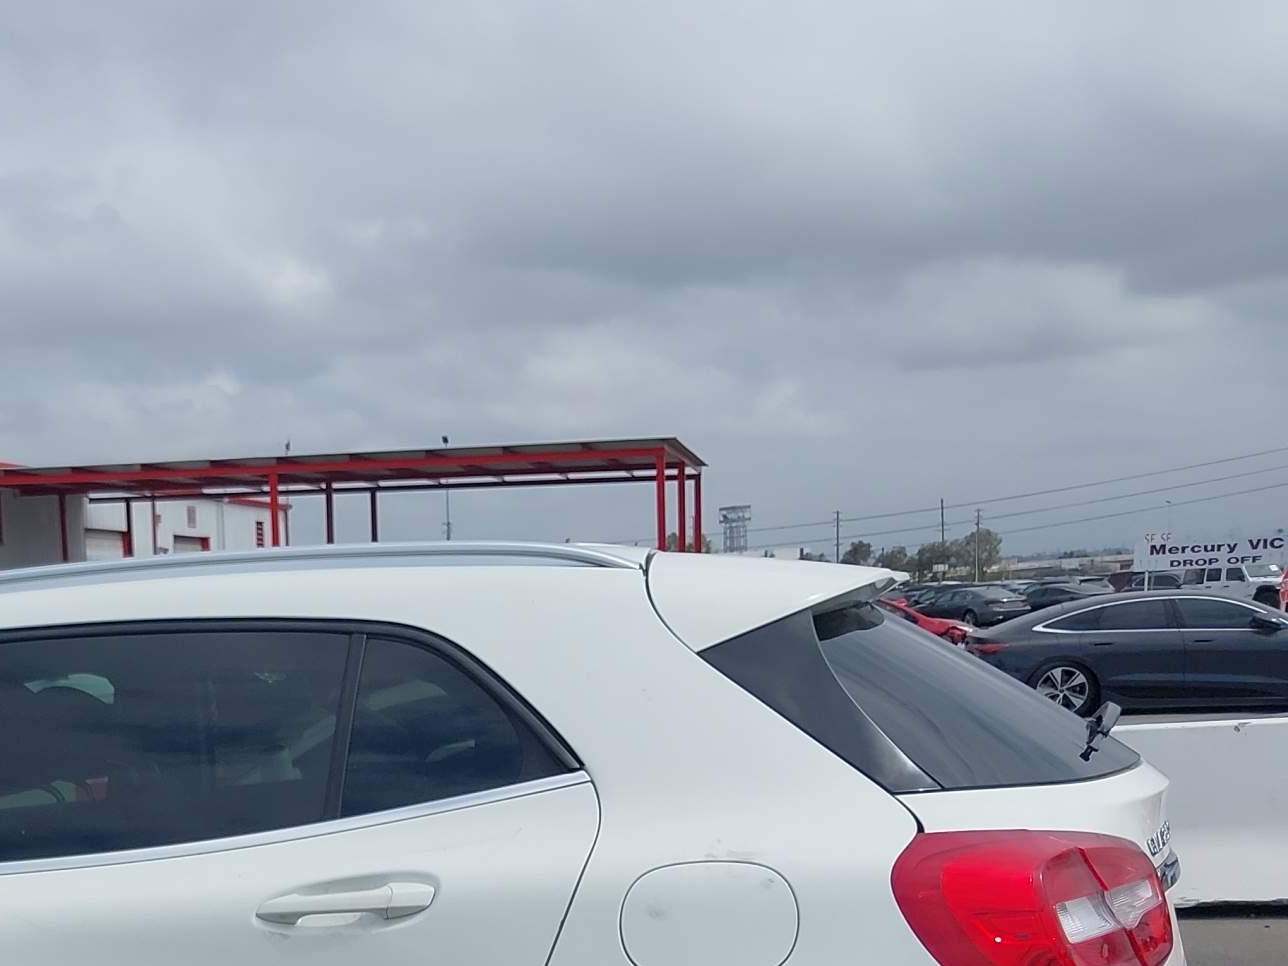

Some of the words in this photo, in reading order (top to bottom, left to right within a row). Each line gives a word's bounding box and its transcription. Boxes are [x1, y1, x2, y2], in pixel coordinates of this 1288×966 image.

[1150, 543, 1238, 556] Mercury
[1248, 537, 1285, 550] VIC
[1169, 557, 1219, 568] DROP
[1227, 555, 1262, 565] OFF
